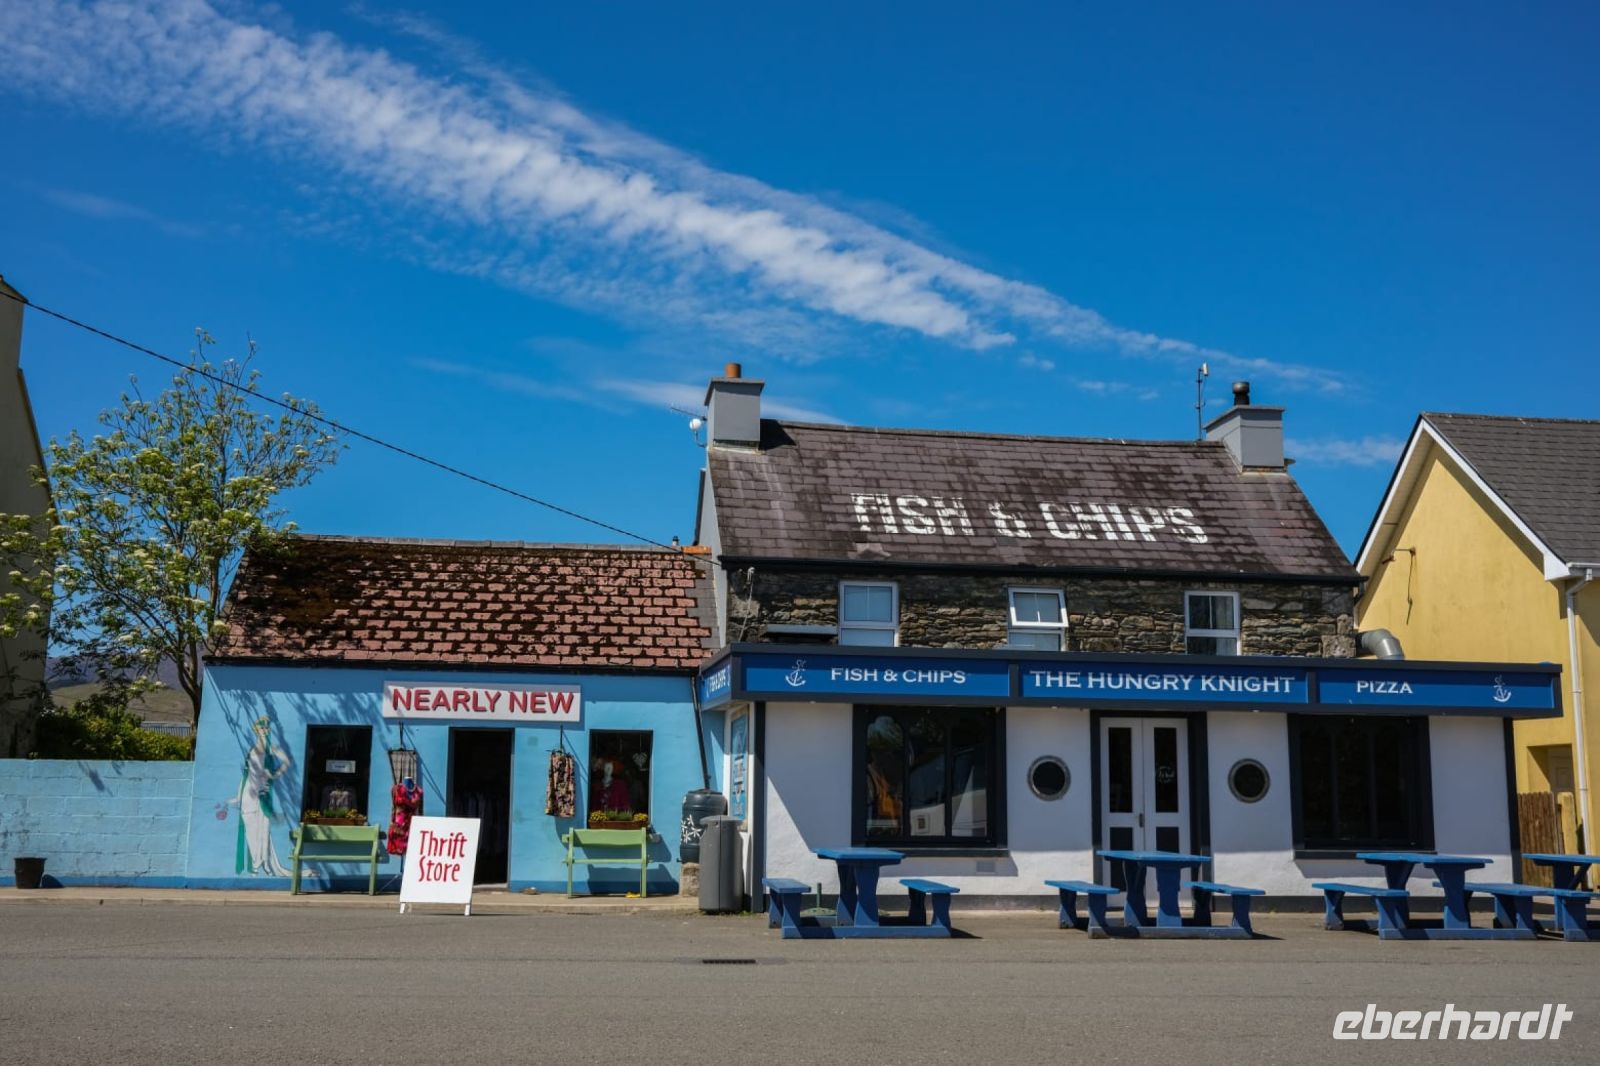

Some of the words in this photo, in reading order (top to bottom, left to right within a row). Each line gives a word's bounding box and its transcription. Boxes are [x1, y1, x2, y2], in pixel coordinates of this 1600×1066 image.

[850, 493, 975, 537] FISH
[988, 501, 1031, 538] &
[1039, 501, 1208, 544] CHIPS
[830, 667, 878, 682] FISH
[883, 669, 898, 683] &
[902, 669, 967, 684] CHIPS
[1029, 670, 1082, 688] THE
[1087, 672, 1194, 691] HUNGRY
[1201, 674, 1295, 693] KNIGHT
[1356, 680, 1413, 694] PIZZA
[392, 688, 502, 713] NEARLY
[509, 691, 574, 714] NEW
[419, 830, 467, 859] Thrift
[418, 856, 461, 882] Store
